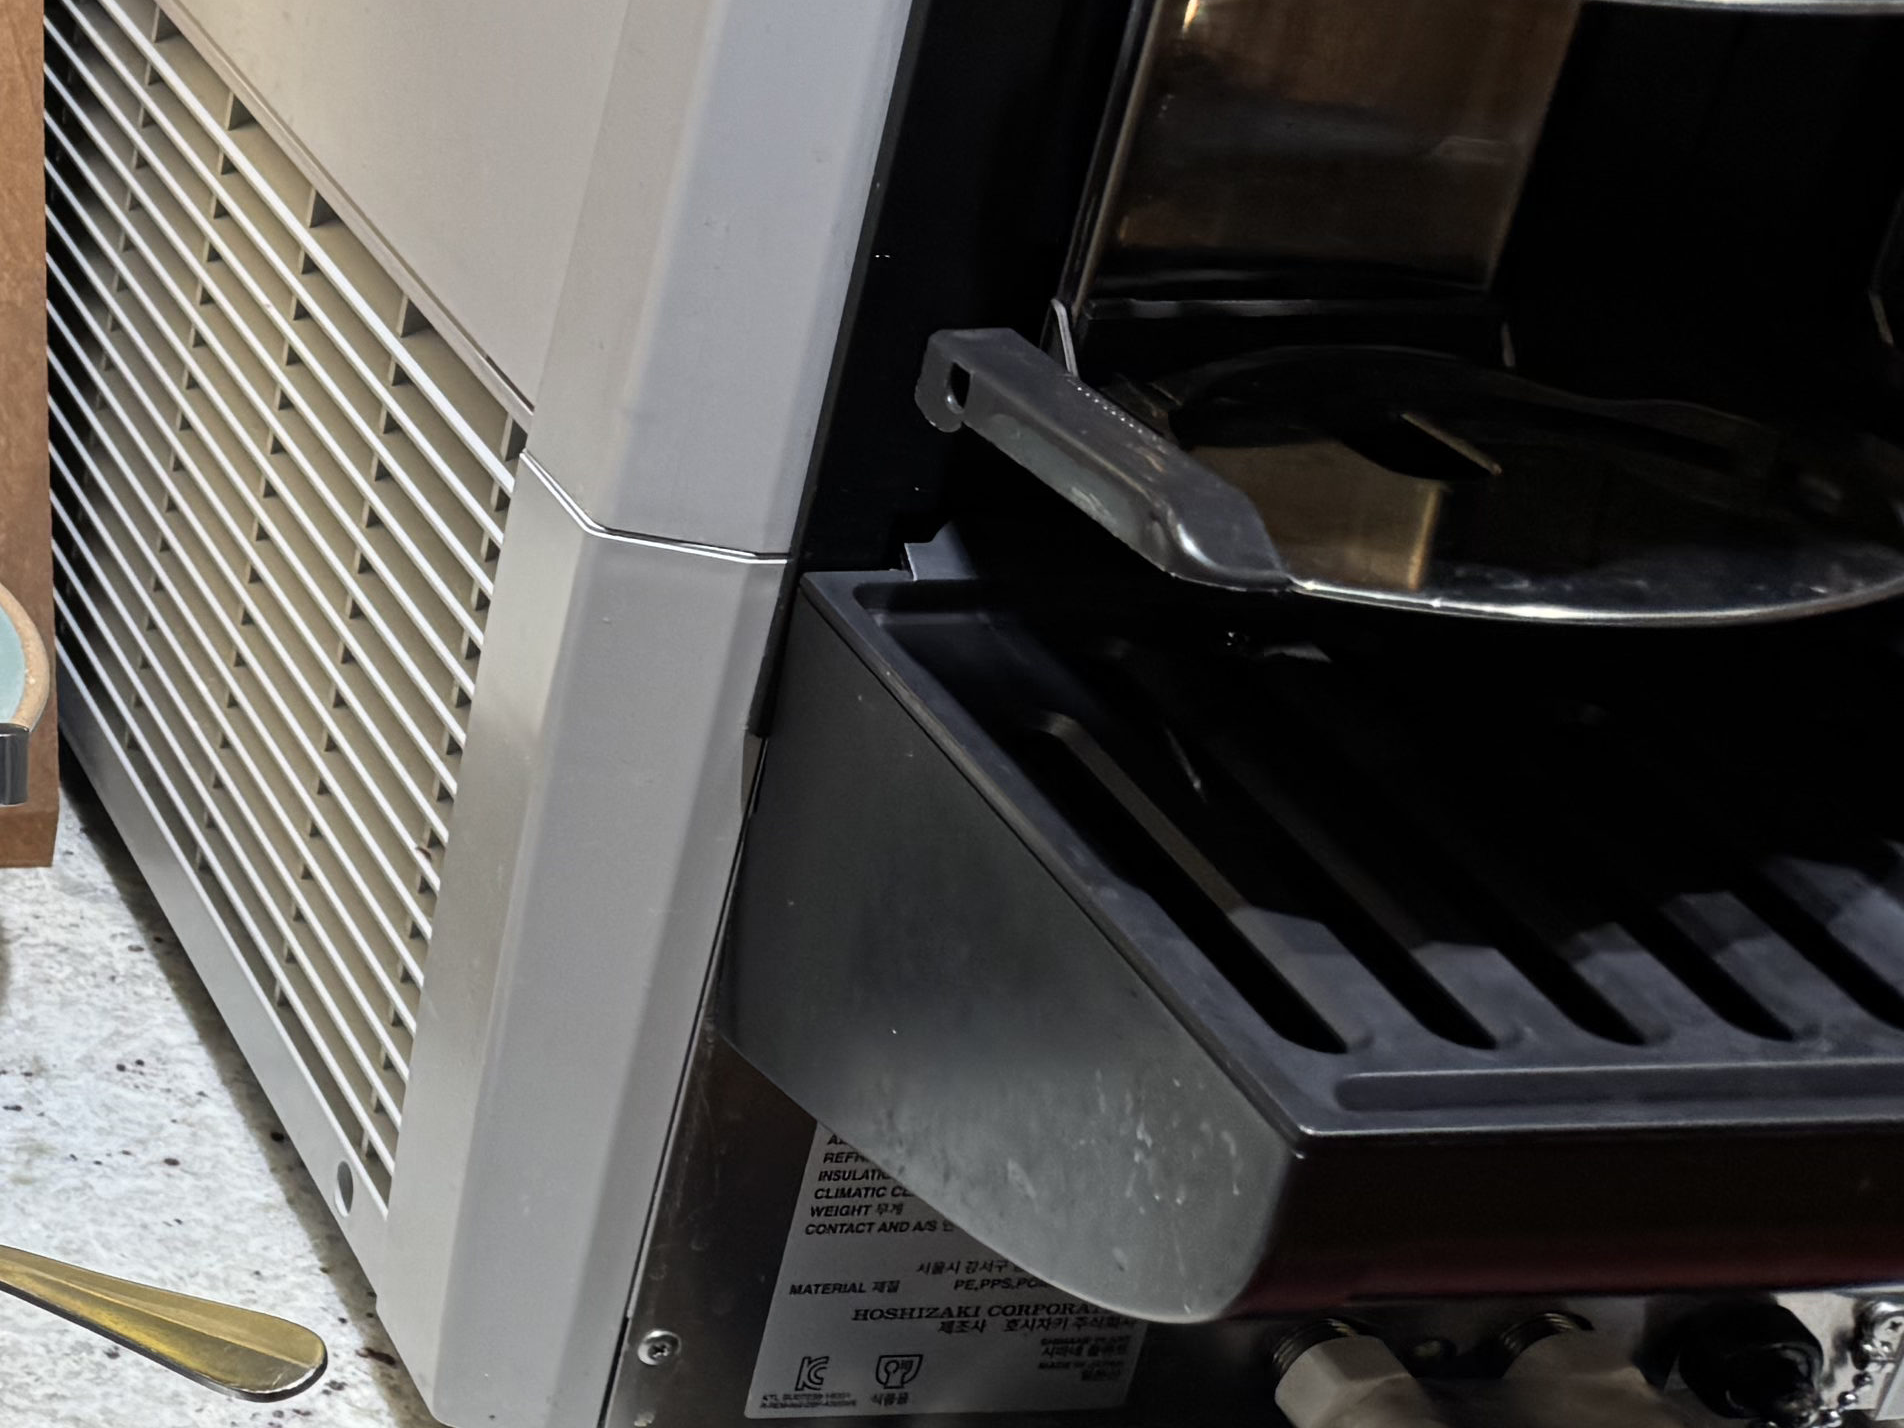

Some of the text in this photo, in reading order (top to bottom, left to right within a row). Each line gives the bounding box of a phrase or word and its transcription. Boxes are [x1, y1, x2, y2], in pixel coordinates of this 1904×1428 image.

[814, 1186, 887, 1199] CLIMATIC
[810, 1204, 872, 1217] WEIGHT
[805, 1222, 875, 1235] CONTACT
[877, 1221, 910, 1233] AND
[912, 1219, 938, 1232] A/S
[788, 1282, 867, 1295] MATERIAL
[851, 1305, 981, 1321] HOSHIZAKI
